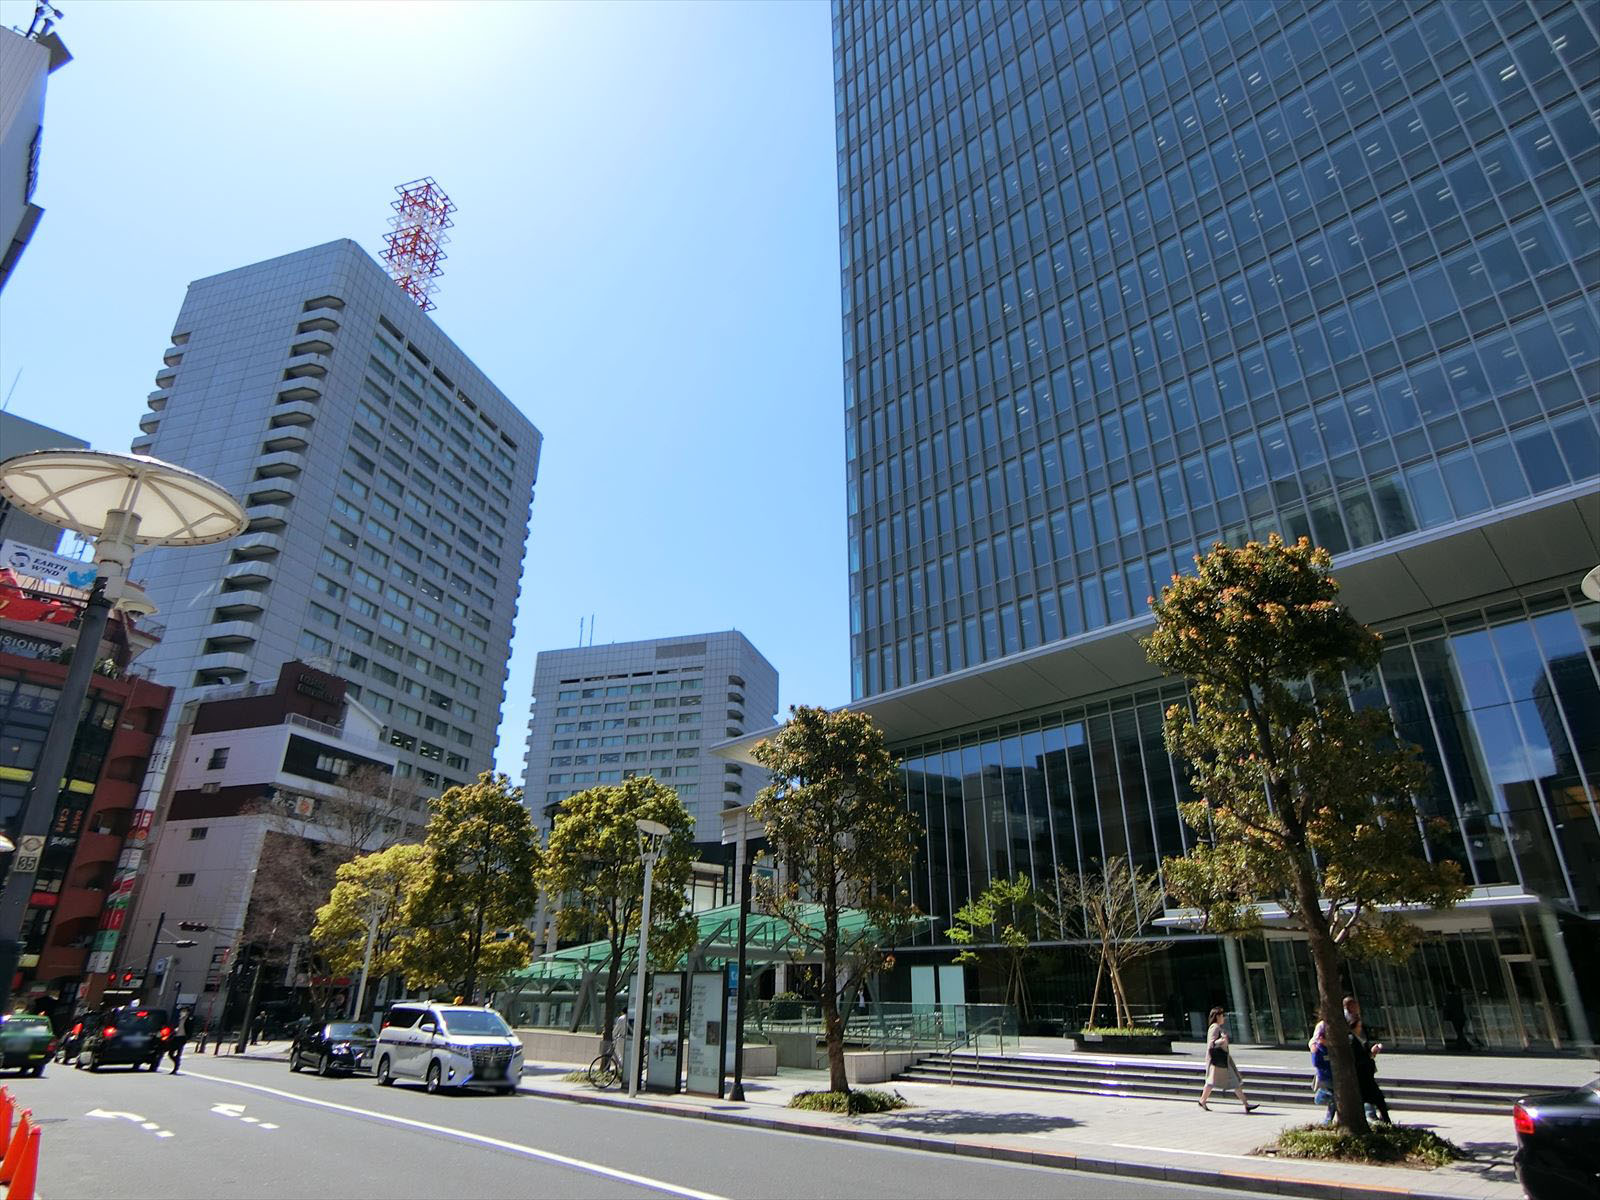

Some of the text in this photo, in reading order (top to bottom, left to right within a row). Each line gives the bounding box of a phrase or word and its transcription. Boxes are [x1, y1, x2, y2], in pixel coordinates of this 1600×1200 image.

[31, 564, 60, 577] WIND
[33, 558, 68, 572] EARTH
[19, 856, 36, 870] 35
